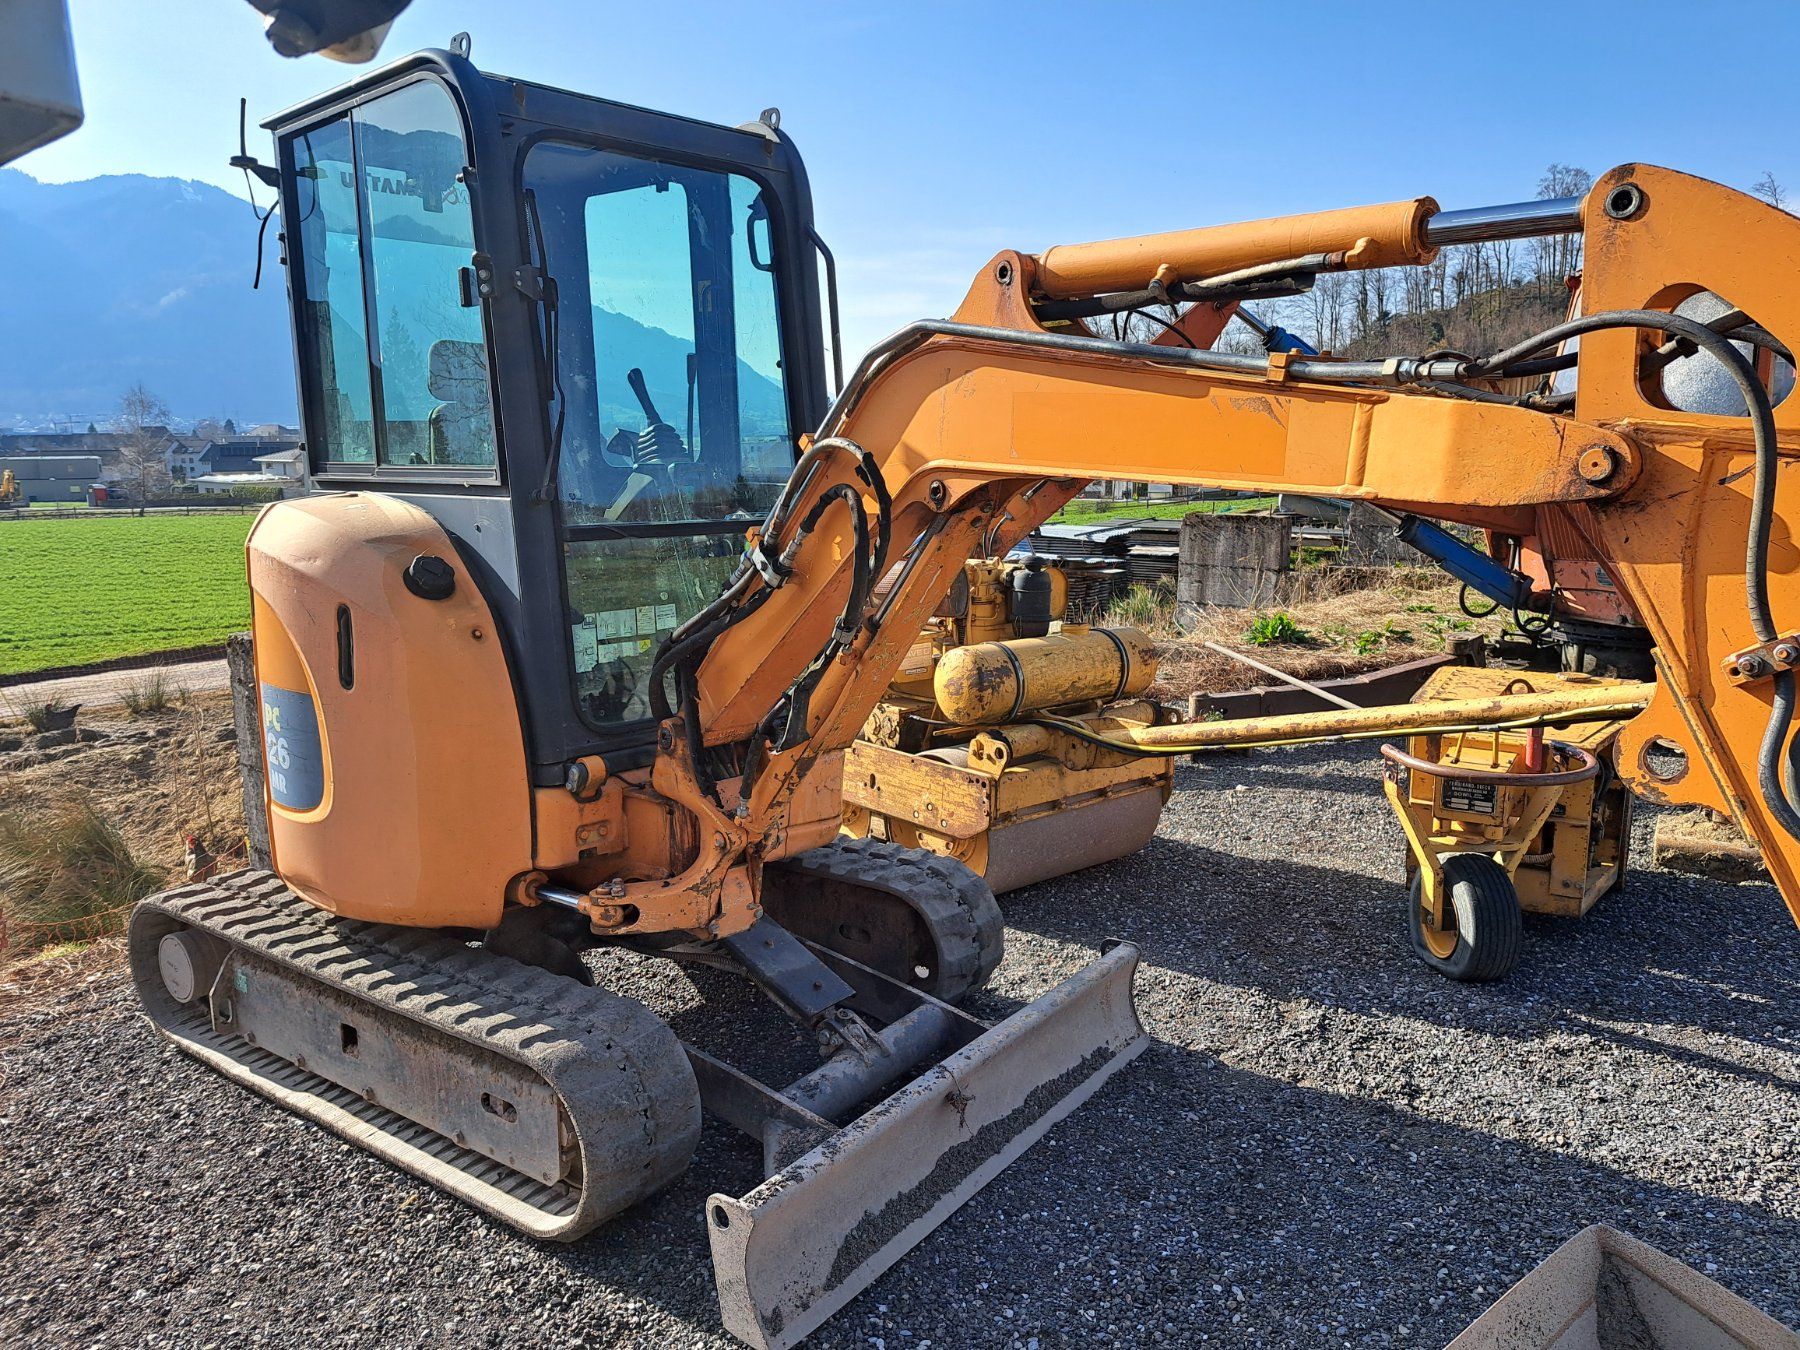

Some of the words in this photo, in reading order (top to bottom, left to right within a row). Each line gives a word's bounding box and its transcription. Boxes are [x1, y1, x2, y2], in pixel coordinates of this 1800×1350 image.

[264, 702, 281, 732] PC
[267, 732, 291, 770] 26
[271, 769, 288, 794] MR
